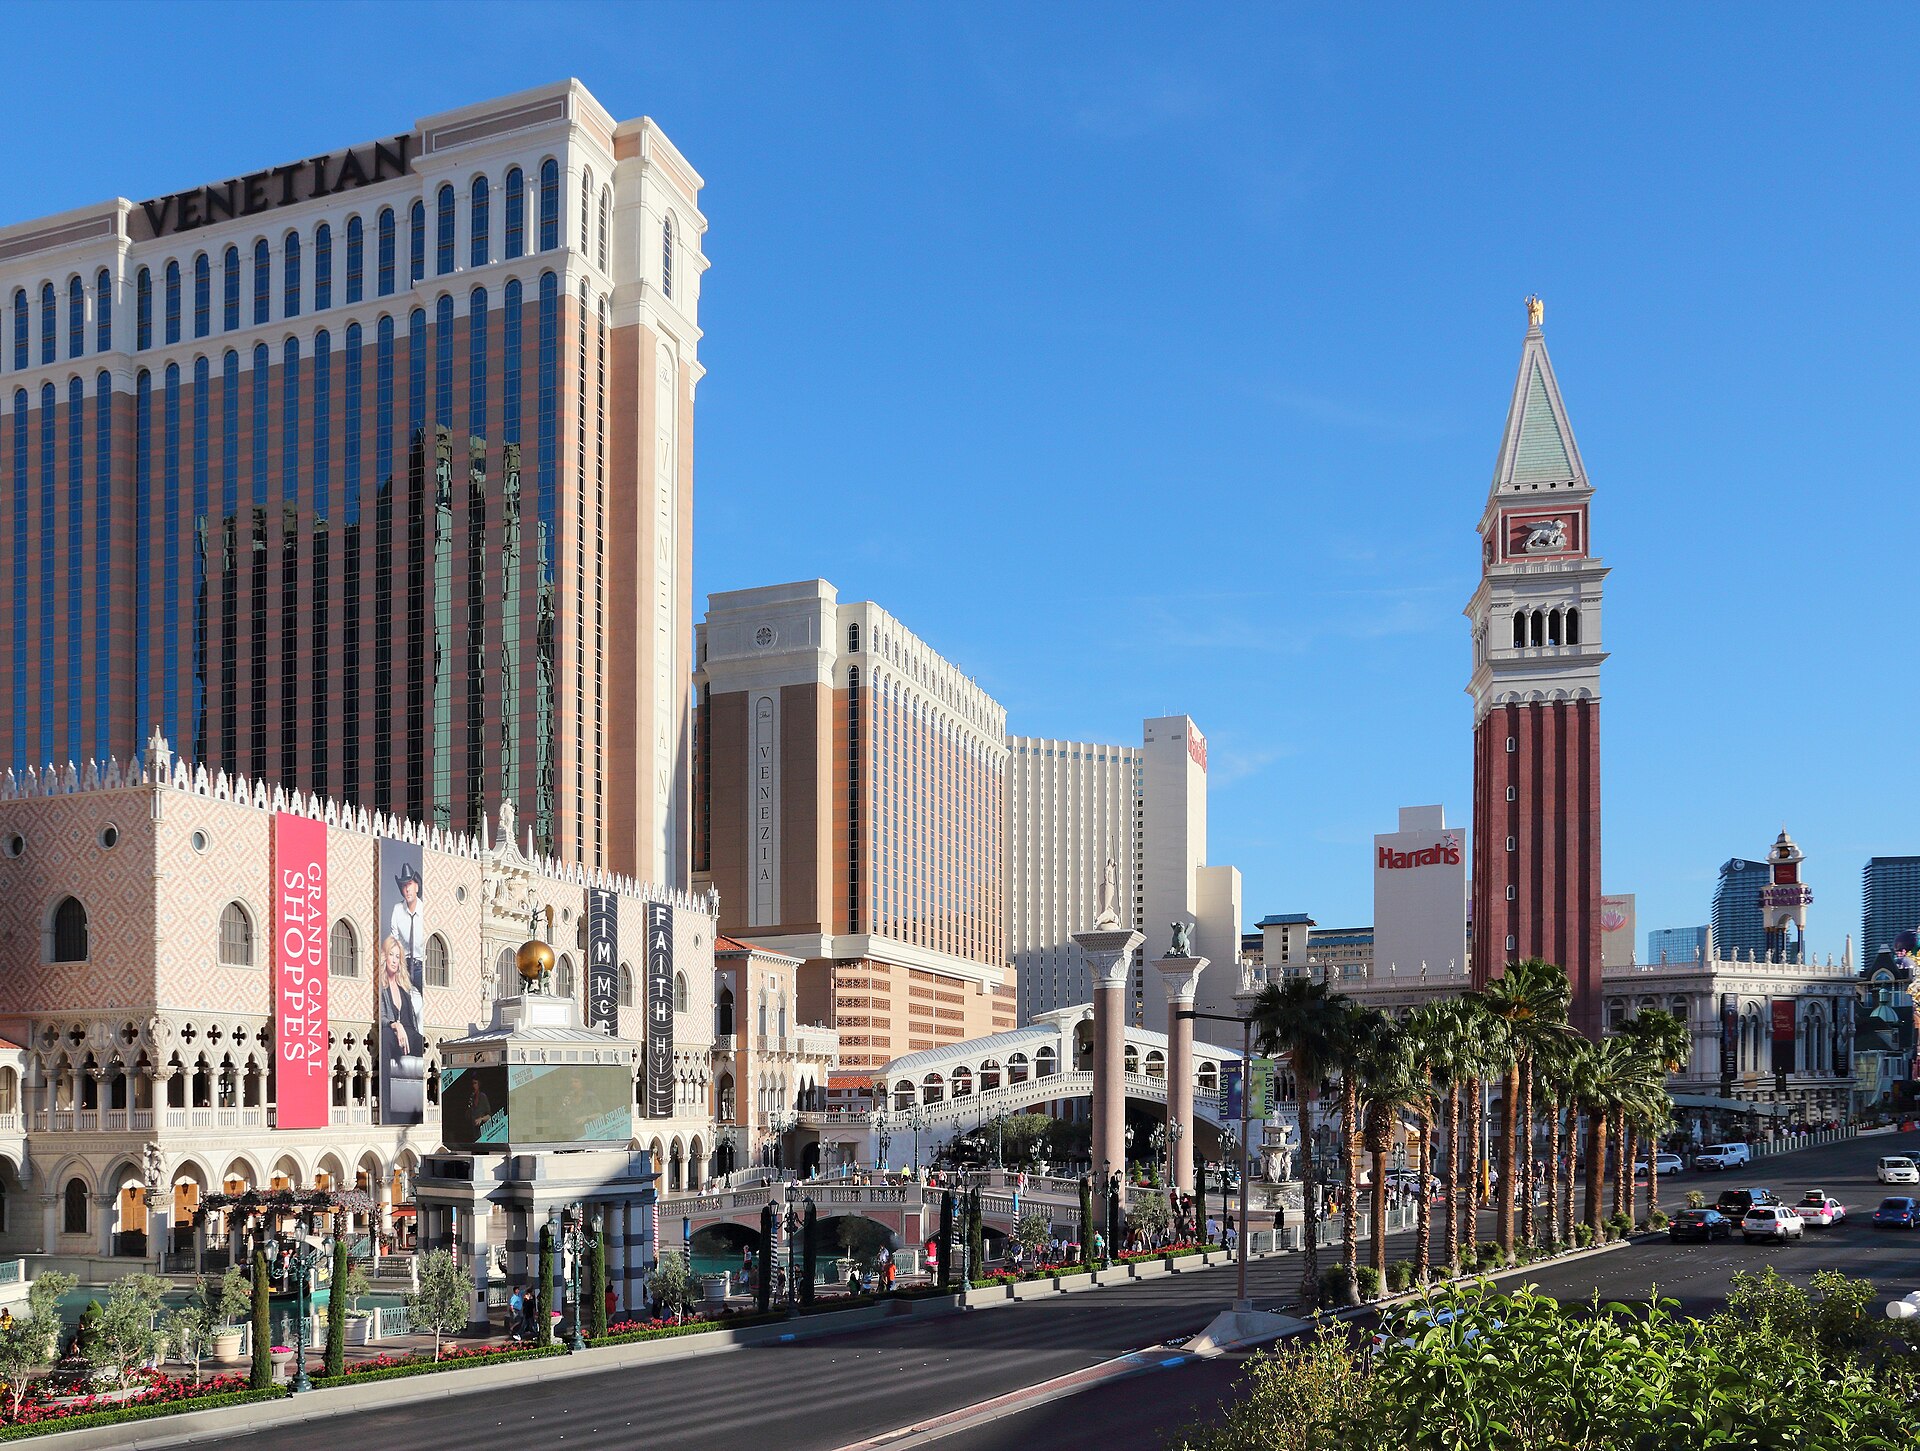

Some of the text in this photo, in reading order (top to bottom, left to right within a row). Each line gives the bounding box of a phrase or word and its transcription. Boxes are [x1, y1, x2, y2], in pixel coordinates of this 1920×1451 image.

[139, 134, 410, 238] VENETIAN
[760, 746, 770, 881] VENEZIA
[283, 869, 305, 1061] SHOPPES
[307, 862, 322, 1076] GRAND CANAL
[597, 891, 610, 964] TIM
[655, 906, 666, 1115] FAITH HILL
[1220, 1073, 1229, 1116] LAS VEGAS
[1264, 1072, 1274, 1115] LAS VEGAS
